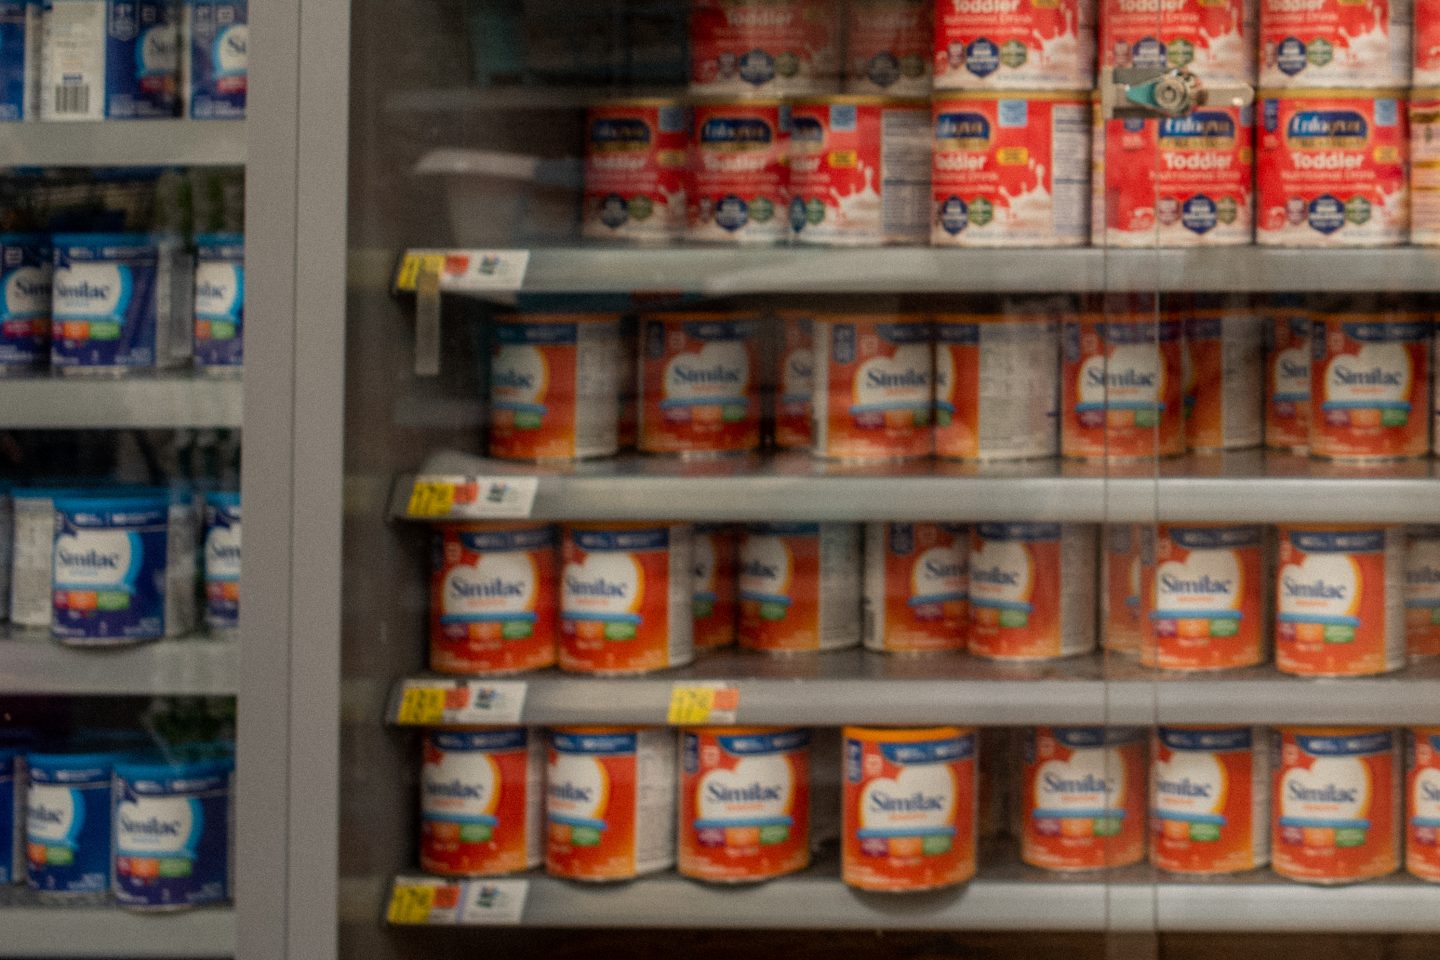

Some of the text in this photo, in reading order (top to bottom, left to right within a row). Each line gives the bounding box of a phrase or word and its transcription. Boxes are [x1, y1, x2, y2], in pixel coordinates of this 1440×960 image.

[1163, 153, 1233, 170] Toddler
[1291, 152, 1365, 170] Toddler
[674, 363, 741, 386] Similac
[1086, 364, 1155, 388] Similac
[1333, 366, 1402, 390] Similac
[60, 546, 120, 570] Similac
[451, 575, 525, 600] Similac
[566, 575, 628, 600] Similac
[1162, 573, 1234, 596] Similac
[1283, 575, 1347, 600] Similac
[707, 780, 783, 805] Similac
[1042, 772, 1115, 795] Similac
[1287, 779, 1358, 803] Similac
[870, 789, 946, 813] Similac
[121, 813, 182, 837] Similac
